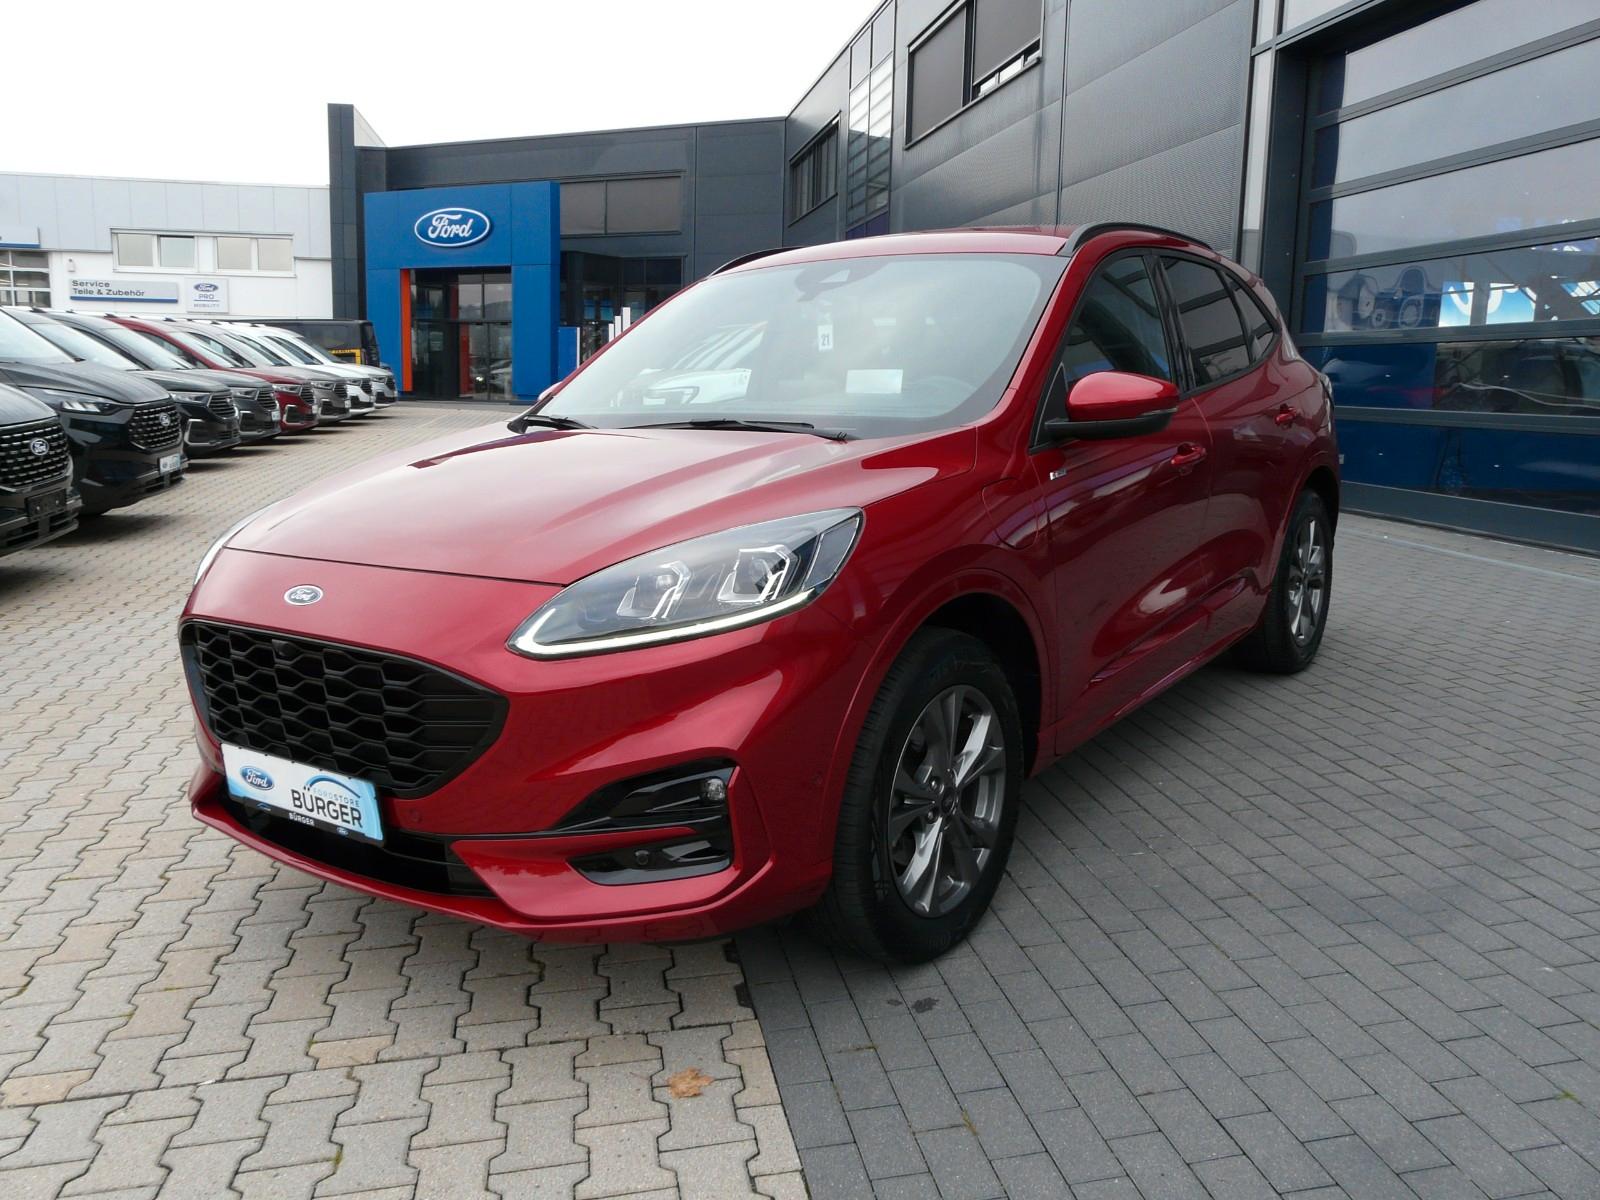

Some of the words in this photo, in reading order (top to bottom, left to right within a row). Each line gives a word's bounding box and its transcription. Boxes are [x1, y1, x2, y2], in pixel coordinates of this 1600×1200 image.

[428, 213, 474, 239] Ford
[72, 280, 110, 288] Service
[106, 289, 145, 297] Zubehör
[290, 588, 316, 601] Ford
[246, 769, 269, 788] Ford
[291, 786, 363, 828] BÜRGER
[288, 812, 315, 827] BÜRGER
